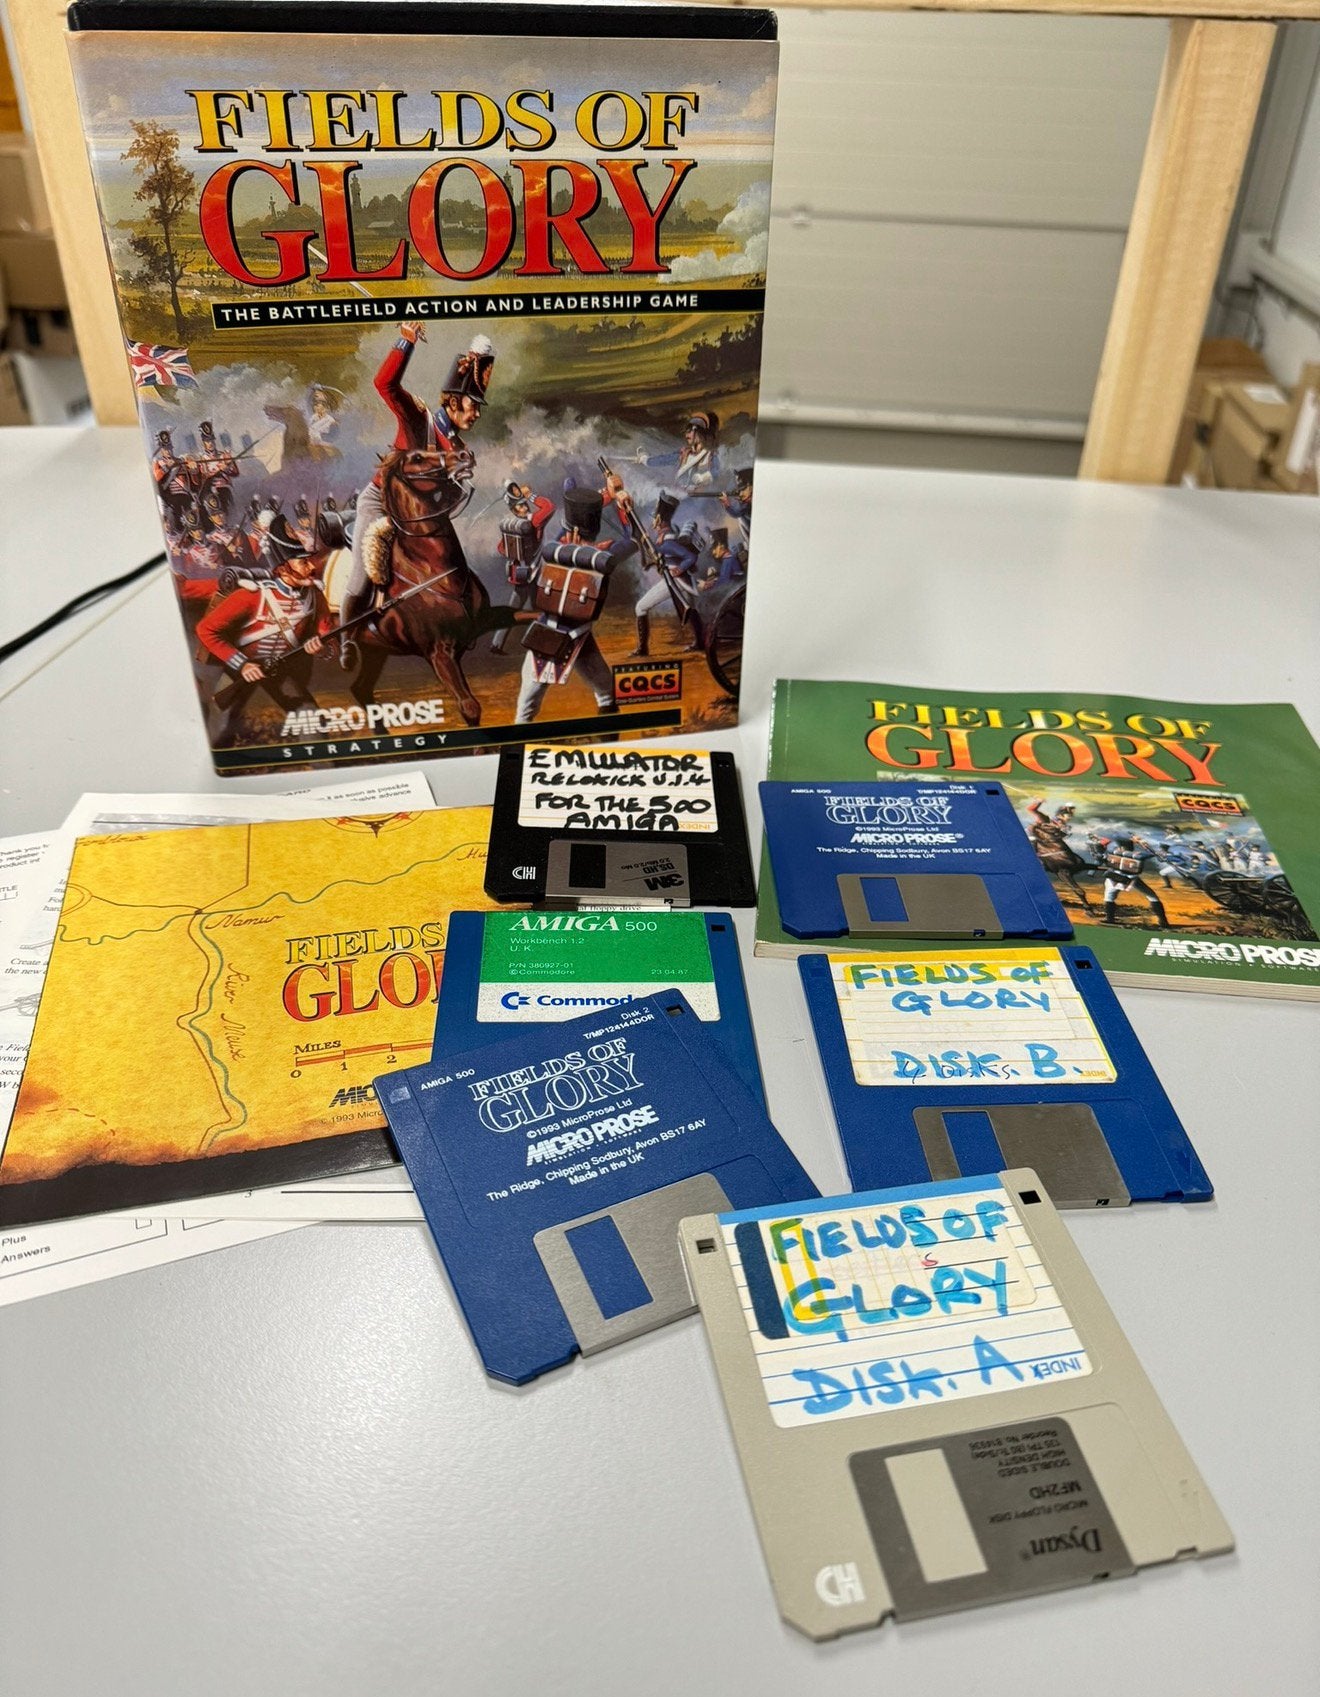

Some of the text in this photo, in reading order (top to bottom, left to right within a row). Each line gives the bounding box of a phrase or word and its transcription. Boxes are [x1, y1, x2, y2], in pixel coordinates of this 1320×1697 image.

[185, 90, 700, 152] FIELDS OF
[200, 157, 699, 286] GLORY
[221, 294, 699, 322] THE BATTLEFIELD ACTION AND LEADERSHIP GAME
[618, 674, 676, 694] CQCS
[866, 699, 1212, 741] FIELDS OF
[282, 734, 449, 759] STRATEGY
[866, 723, 1227, 787] GLORY
[536, 793, 712, 814] FOR THE 500
[824, 796, 950, 807] FIELDS OF
[1181, 798, 1236, 810] CQCS
[563, 811, 680, 831] AMIGA
[825, 805, 953, 826] GLORY
[860, 846, 900, 855] Chipping
[643, 873, 685, 891] 3M
[205, 914, 285, 929] Namur
[508, 915, 657, 932] AMIGA 500
[285, 922, 446, 965] FIELDS
[224, 962, 250, 1005] River
[851, 963, 998, 990] FIELDS
[620, 1006, 650, 1020] Disk 2
[891, 987, 1051, 1017] GLORY
[293, 1040, 342, 1055] MILES
[341, 1062, 348, 1071] 1
[386, 1055, 397, 1064] 2
[468, 1037, 628, 1101] FIELDS OF
[420, 1068, 476, 1091] AMIGA 500
[478, 1052, 645, 1134] GLORY
[331, 1113, 355, 1124] 1993
[526, 1098, 633, 1139] ©1993 MicroProse Ltd
[486, 1119, 708, 1202] The Ridge, Chipping Sodbury, Avon BS17 6AY
[568, 1152, 646, 1186] Made in the UK
[1, 1234, 27, 1247] Plus
[770, 1200, 1009, 1264] FIELDS OF
[1, 1246, 51, 1264] Answers
[783, 1260, 1009, 1343] GLORY
[971, 1334, 1026, 1386] A
[1028, 1480, 1082, 1500] MF2HD
